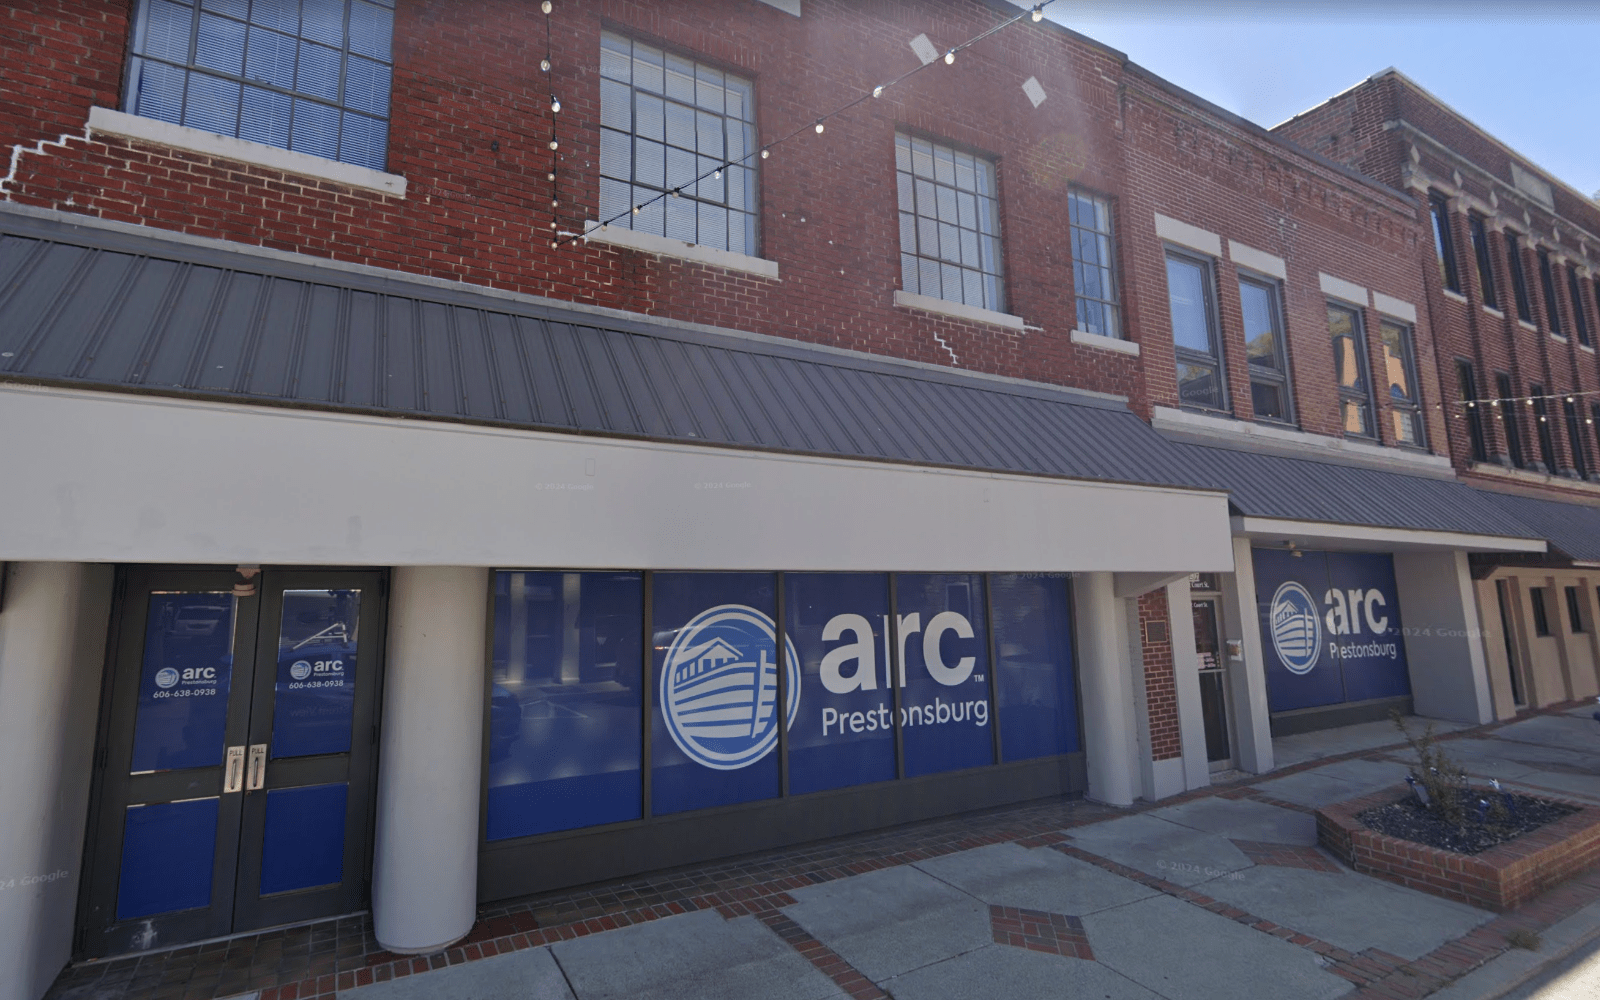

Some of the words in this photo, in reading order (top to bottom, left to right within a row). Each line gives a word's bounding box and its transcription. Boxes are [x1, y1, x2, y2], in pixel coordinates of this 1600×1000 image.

[1324, 588, 1388, 636] arc
[819, 611, 977, 695] arc
[1329, 640, 1397, 660] Prestonsburg
[313, 660, 344, 672] arc
[182, 667, 216, 680] arc
[288, 680, 344, 690] 606-638-0938
[153, 688, 217, 699] 606-638-0938
[822, 697, 989, 737] Prestonsburg
[229, 749, 243, 757] PULL
[251, 747, 265, 755] PULL
